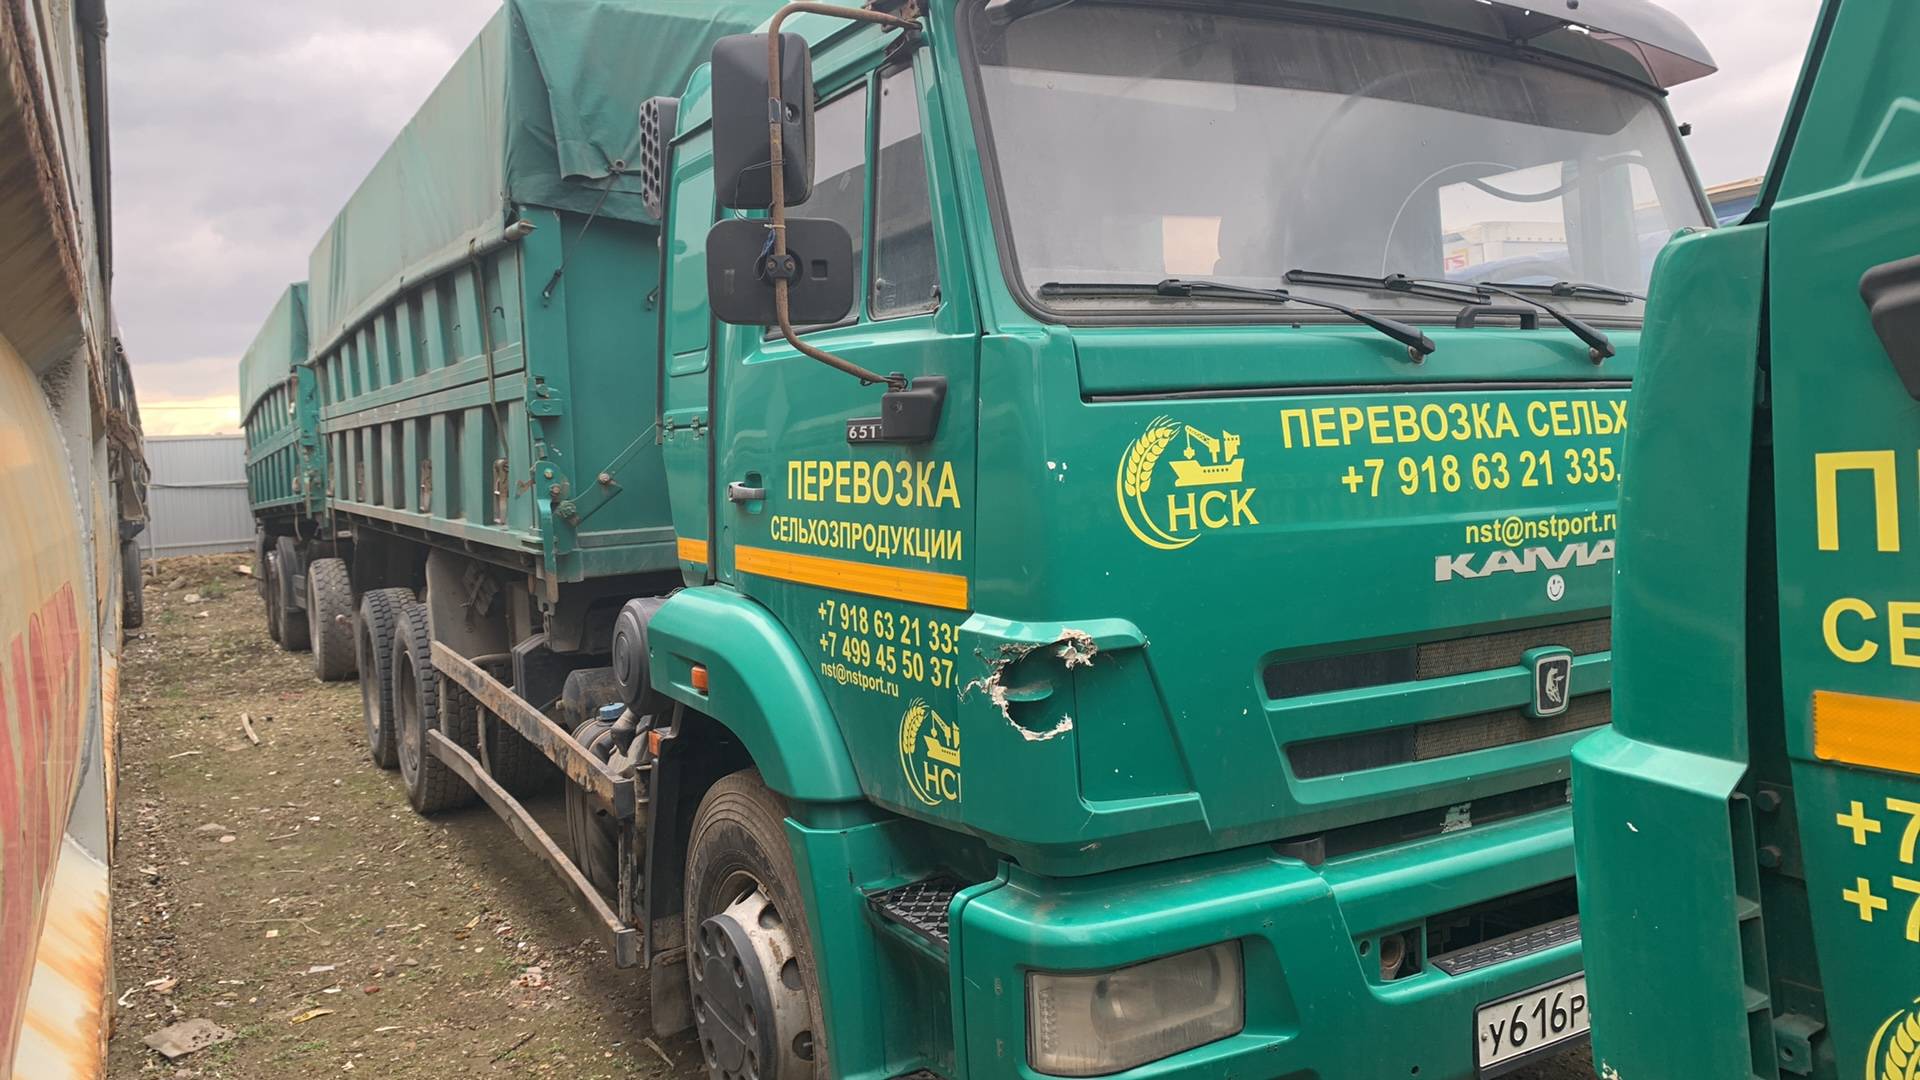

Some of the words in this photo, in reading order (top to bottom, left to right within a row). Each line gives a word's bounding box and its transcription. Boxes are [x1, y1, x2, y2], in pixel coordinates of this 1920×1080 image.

[849, 425, 882, 439] 651
[1280, 402, 1520, 449] ПЕРЕВОЗКА
[1527, 400, 1627, 437] СЕЛЬХ
[788, 460, 961, 508] ПЕРЕВОЗКА
[1342, 458, 1385, 497] +7
[1398, 454, 1461, 496] 918
[1472, 452, 1511, 490] 63
[1519, 449, 1553, 487] 21
[1167, 488, 1260, 532] НСК
[1815, 449, 1920, 553] П
[770, 515, 962, 564] СЕЛЬХОЗПРОДУКЦИИ
[818, 600, 835, 626] +7
[840, 602, 869, 635] 918
[873, 610, 895, 641] 63
[900, 615, 921, 647] 21
[819, 631, 837, 658] +7
[842, 635, 871, 667] 499
[875, 644, 897, 675] 45
[902, 650, 924, 682] 50
[929, 656, 959, 689] 37
[821, 662, 899, 697] nst@nstport.ru
